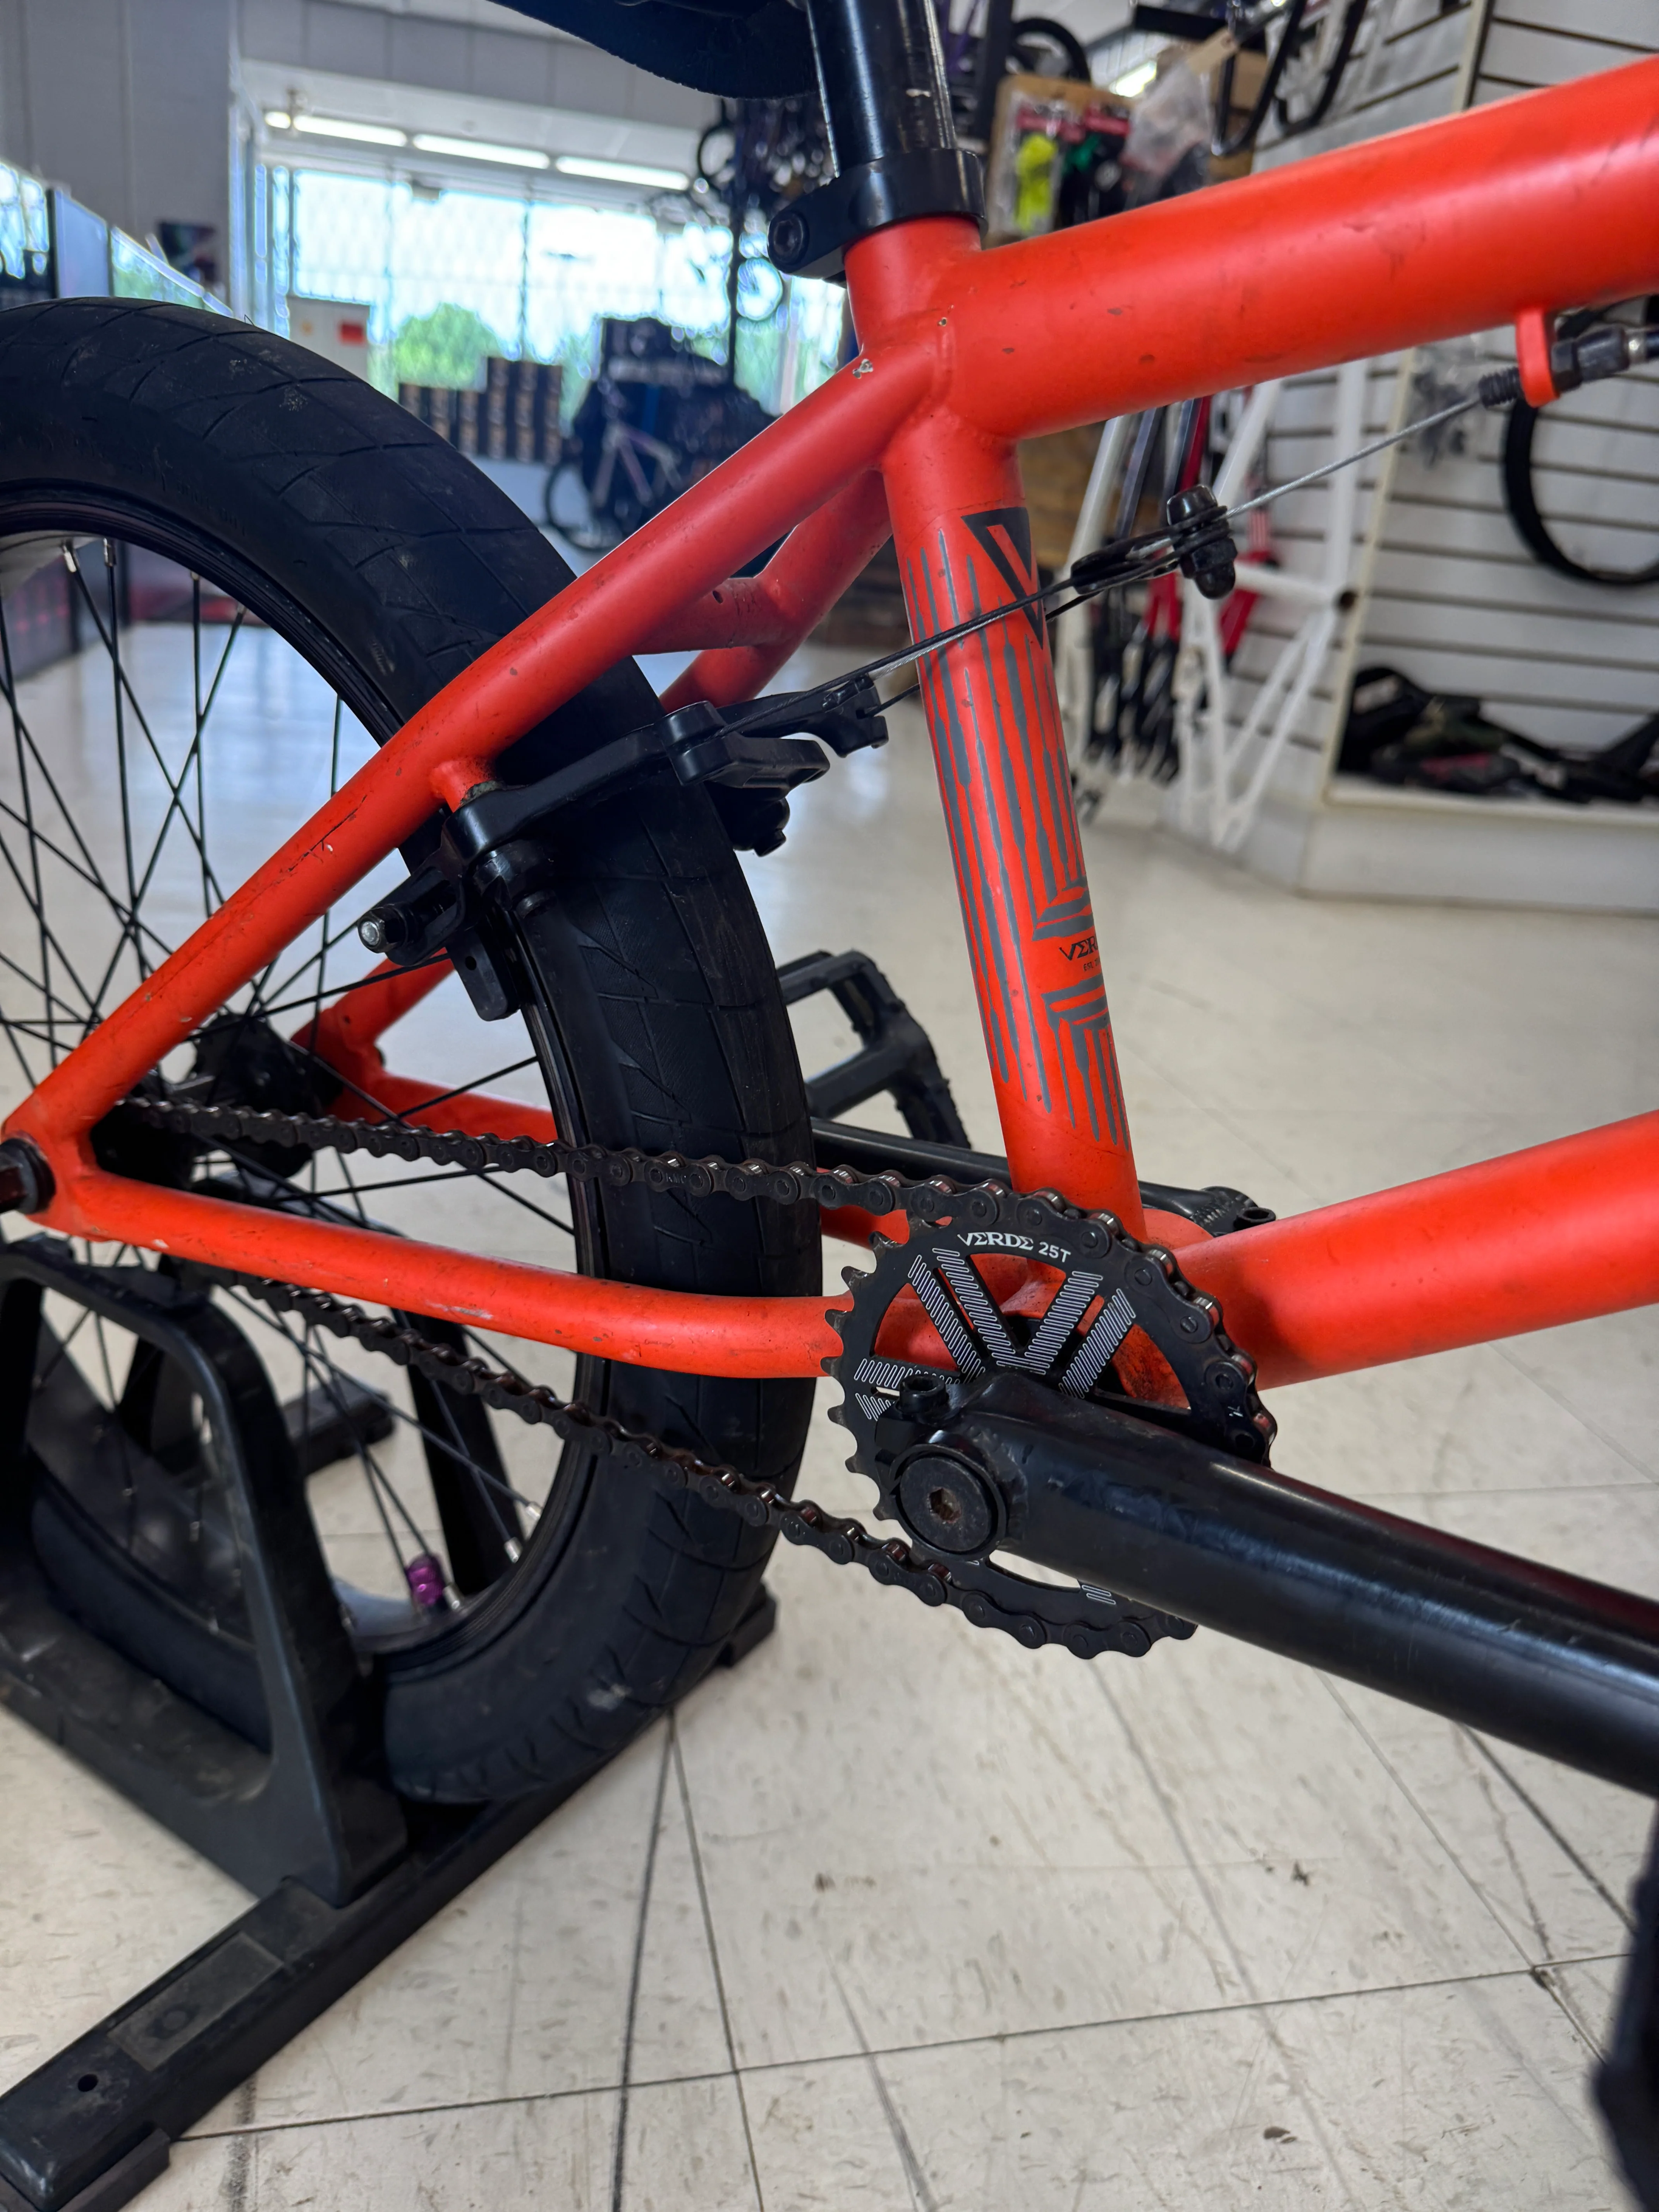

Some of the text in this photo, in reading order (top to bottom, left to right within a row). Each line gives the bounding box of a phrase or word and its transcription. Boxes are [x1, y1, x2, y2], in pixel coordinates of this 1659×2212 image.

[1059, 936, 1098, 960] VER
[957, 1232, 1071, 1262] VERDE 25T
